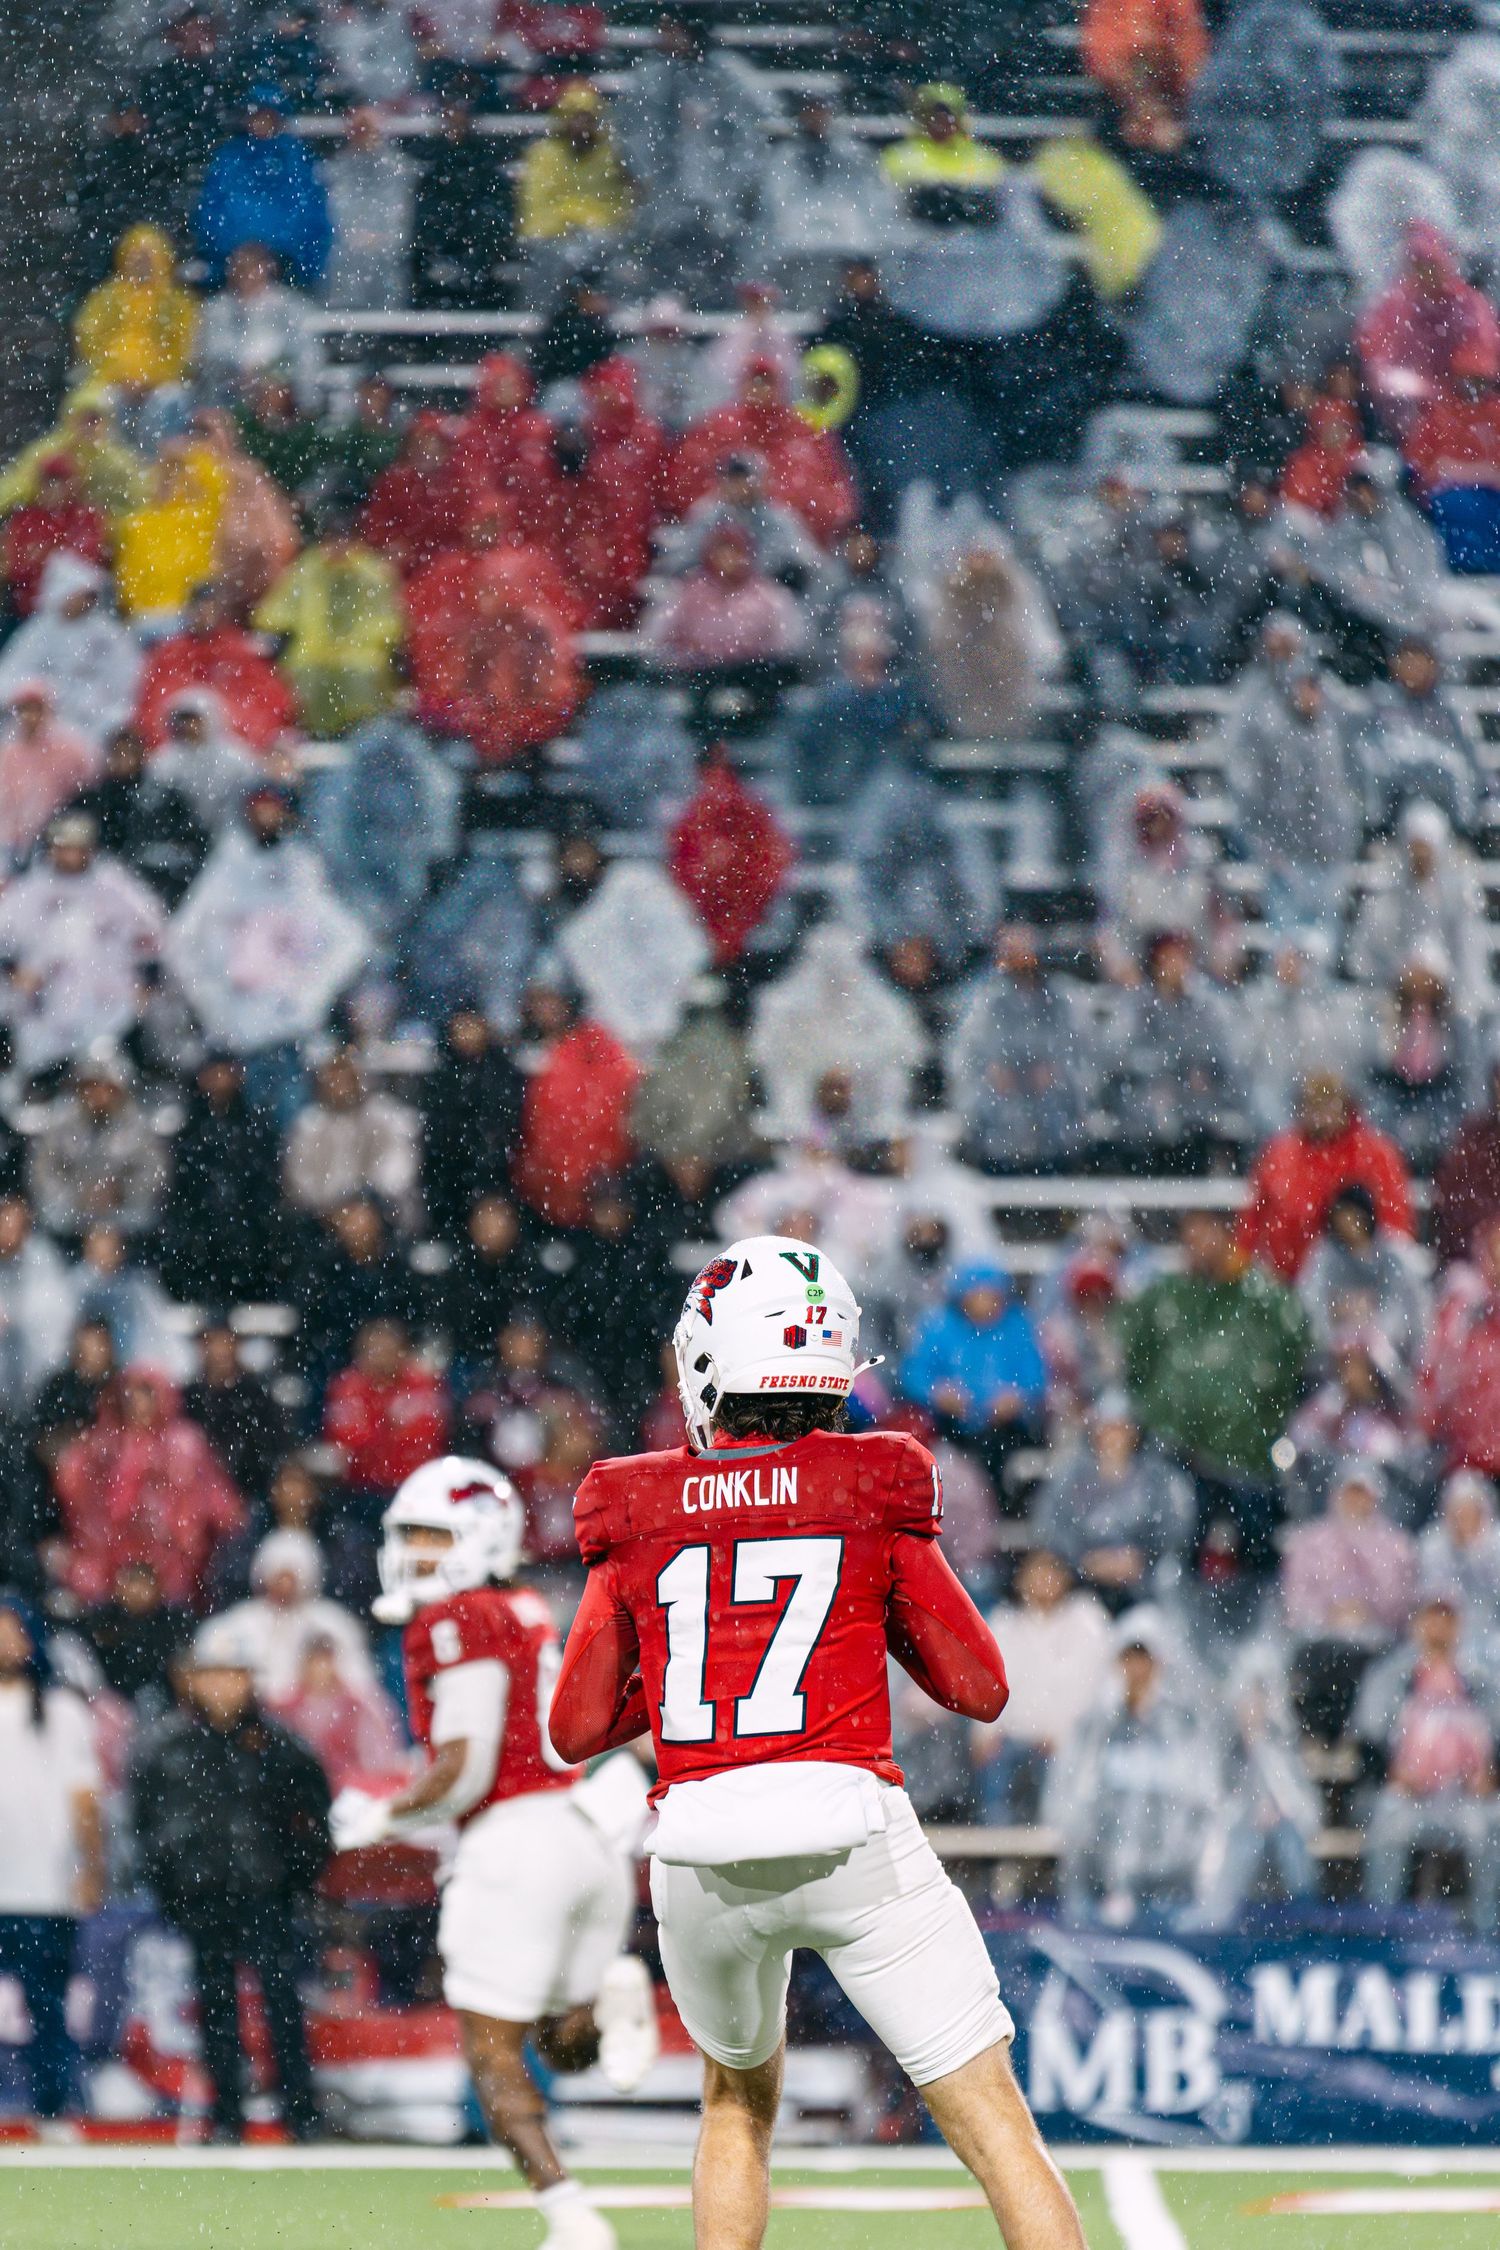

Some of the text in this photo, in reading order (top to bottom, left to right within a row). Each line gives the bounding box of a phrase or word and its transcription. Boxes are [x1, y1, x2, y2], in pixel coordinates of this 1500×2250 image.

[806, 1288, 824, 1298] C2P
[805, 1305, 827, 1324] 17
[759, 1375, 849, 1390] FRESNO STATE
[681, 1465, 799, 1515] CONKLIN
[655, 1535, 845, 1745] 17
[1029, 1998, 1221, 2116] MB
